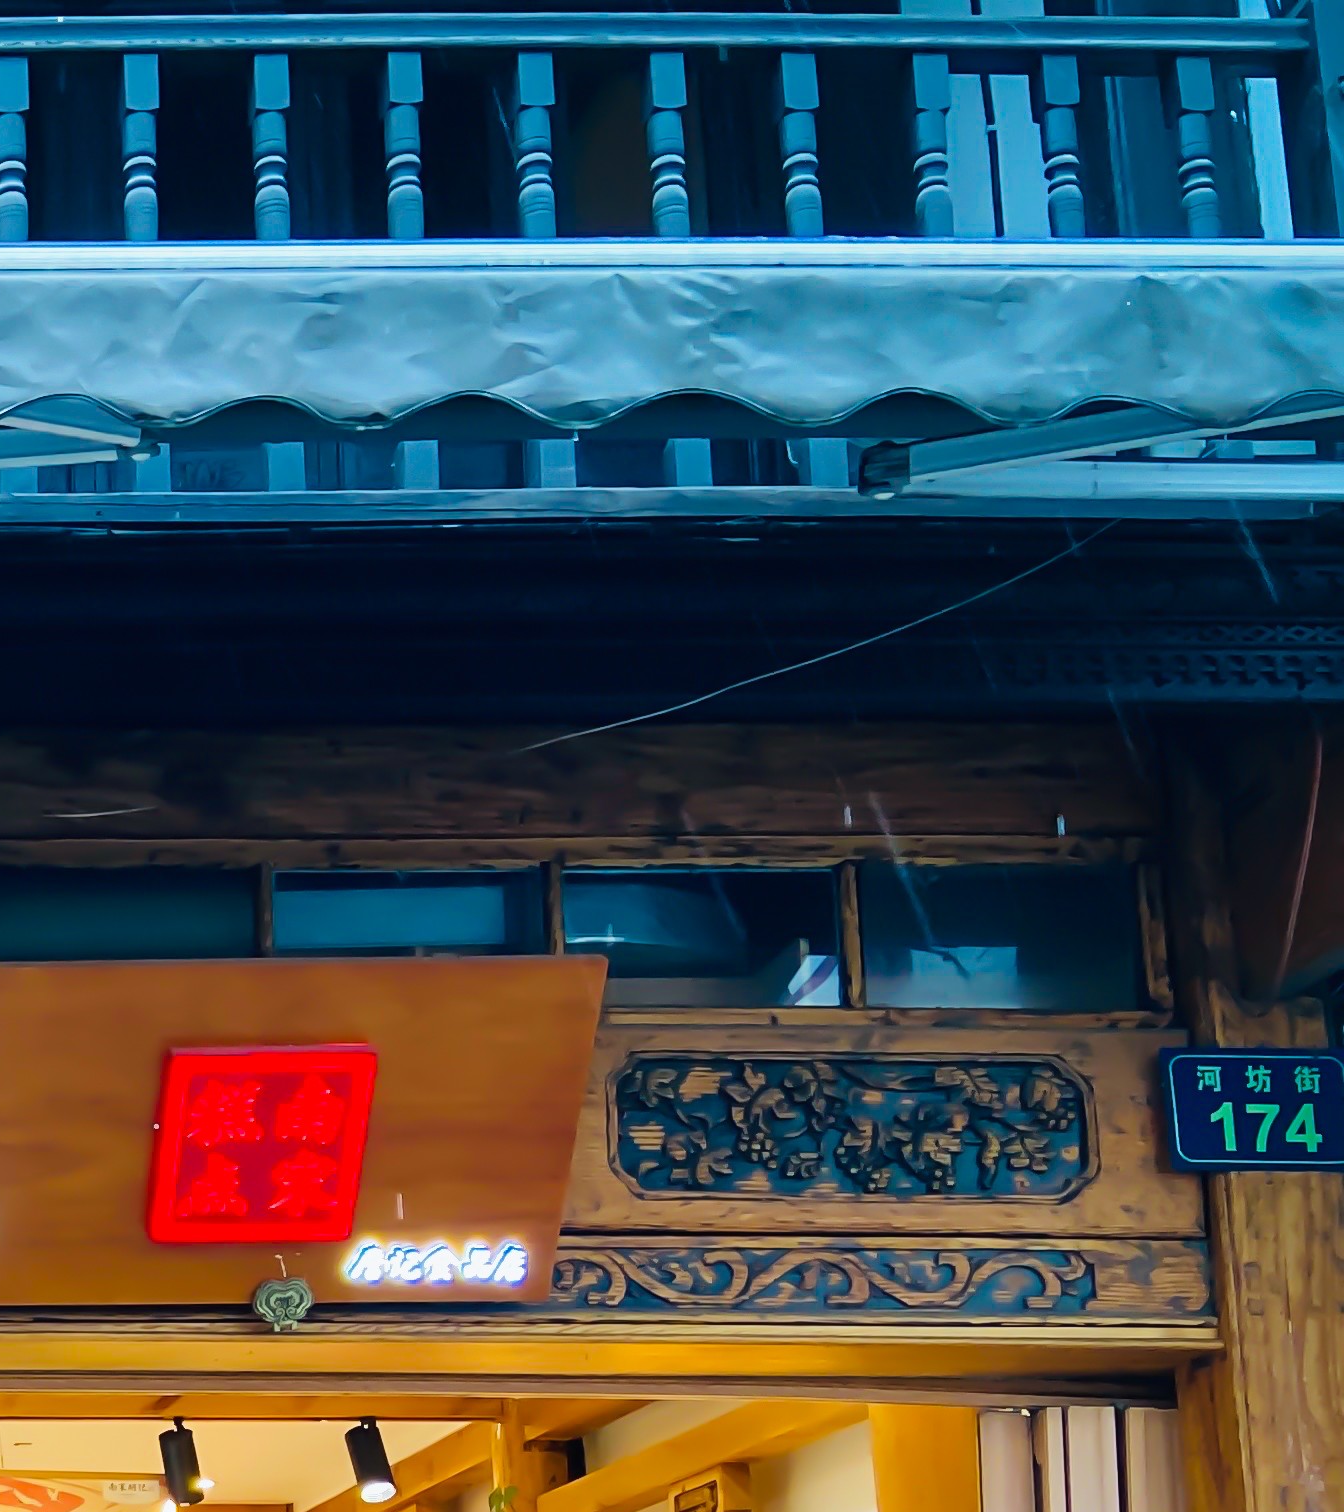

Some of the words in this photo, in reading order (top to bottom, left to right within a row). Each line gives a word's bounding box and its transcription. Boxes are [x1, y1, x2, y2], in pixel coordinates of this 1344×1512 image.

[1196, 1064, 1321, 1094] 河坊街
[1210, 1101, 1323, 1153] 174
